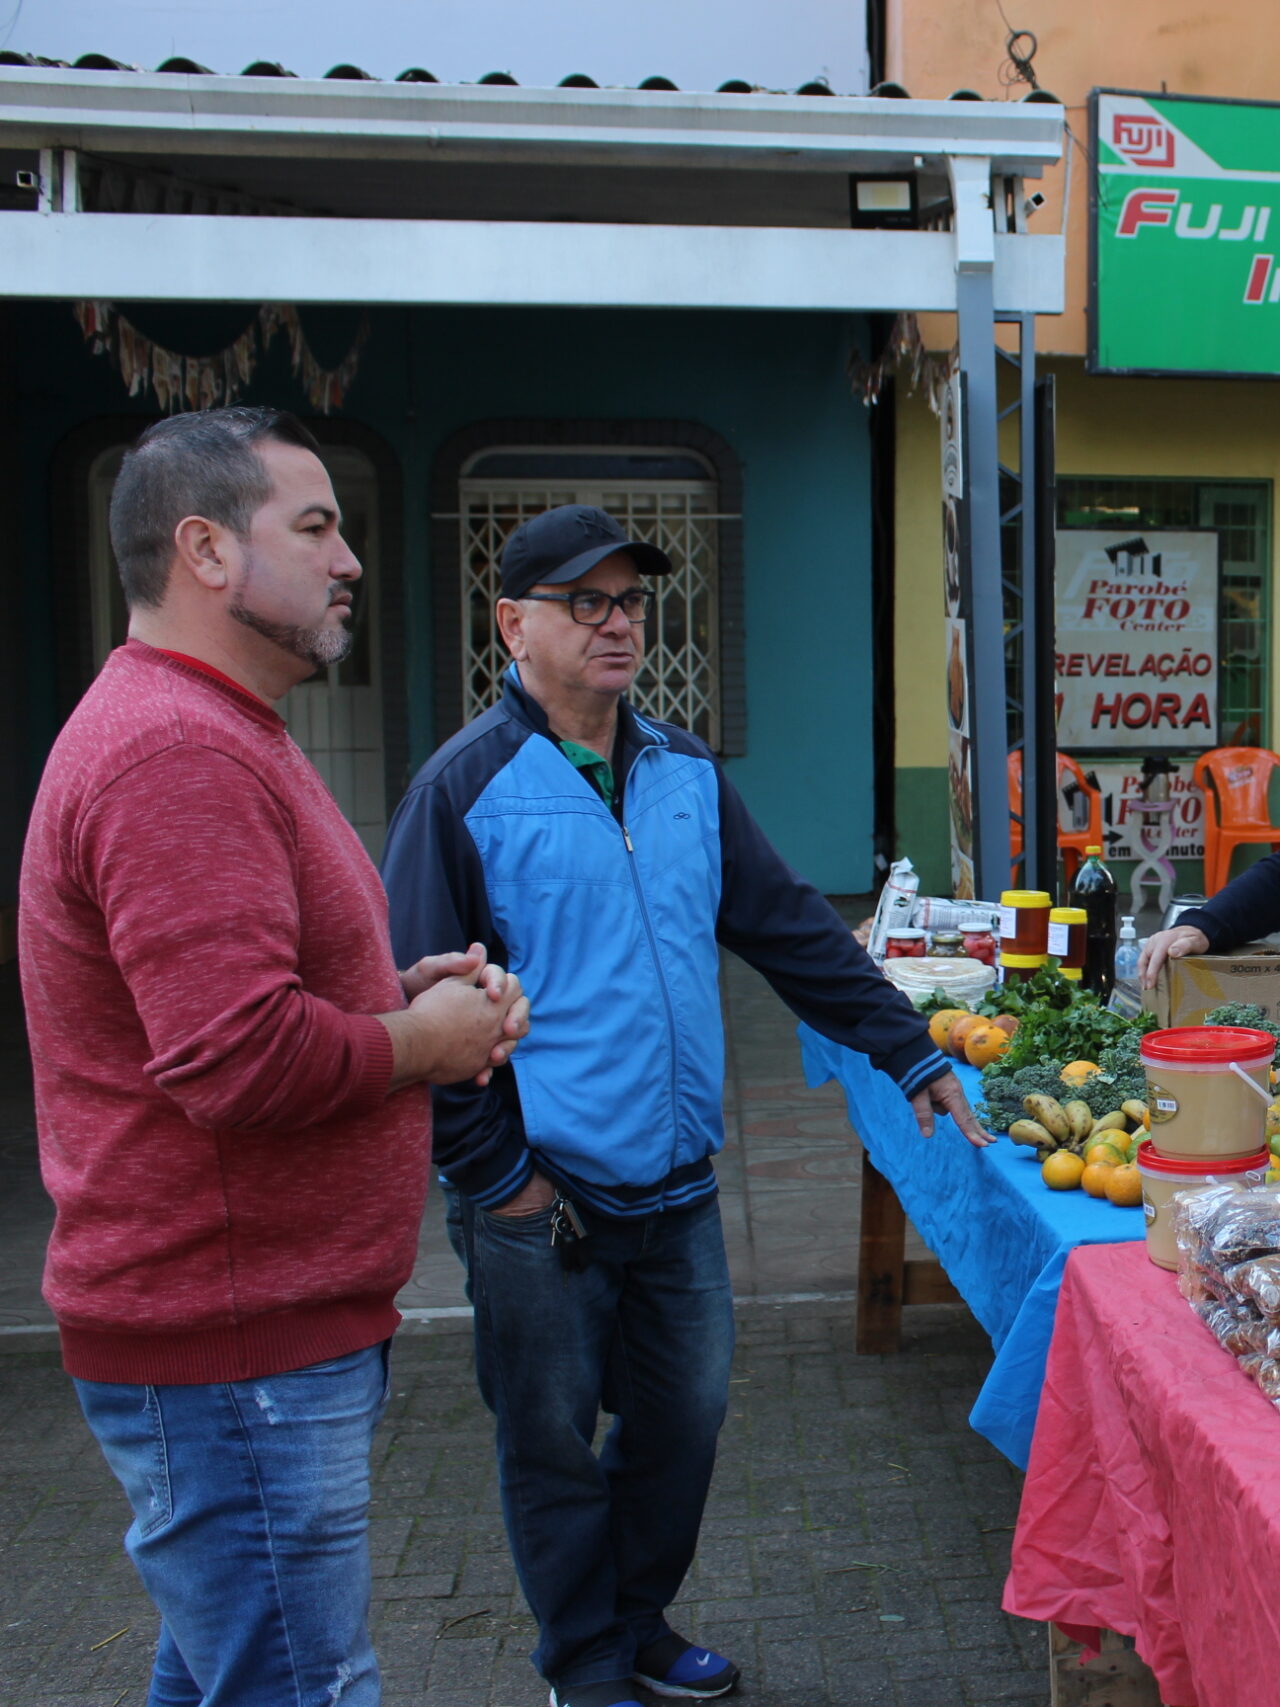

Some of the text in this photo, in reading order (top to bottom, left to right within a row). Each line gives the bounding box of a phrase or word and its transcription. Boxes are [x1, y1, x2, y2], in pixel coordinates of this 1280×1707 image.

[1115, 188, 1271, 242] FUJI
[1088, 579, 1187, 596] Parobé
[1082, 597, 1190, 621] FOTO
[1120, 620, 1186, 632] Center
[1055, 648, 1212, 682] REVELAÇÃO
[1091, 692, 1212, 730] HORA
[1108, 846, 1131, 857] em
[1230, 965, 1261, 973] 30cm
